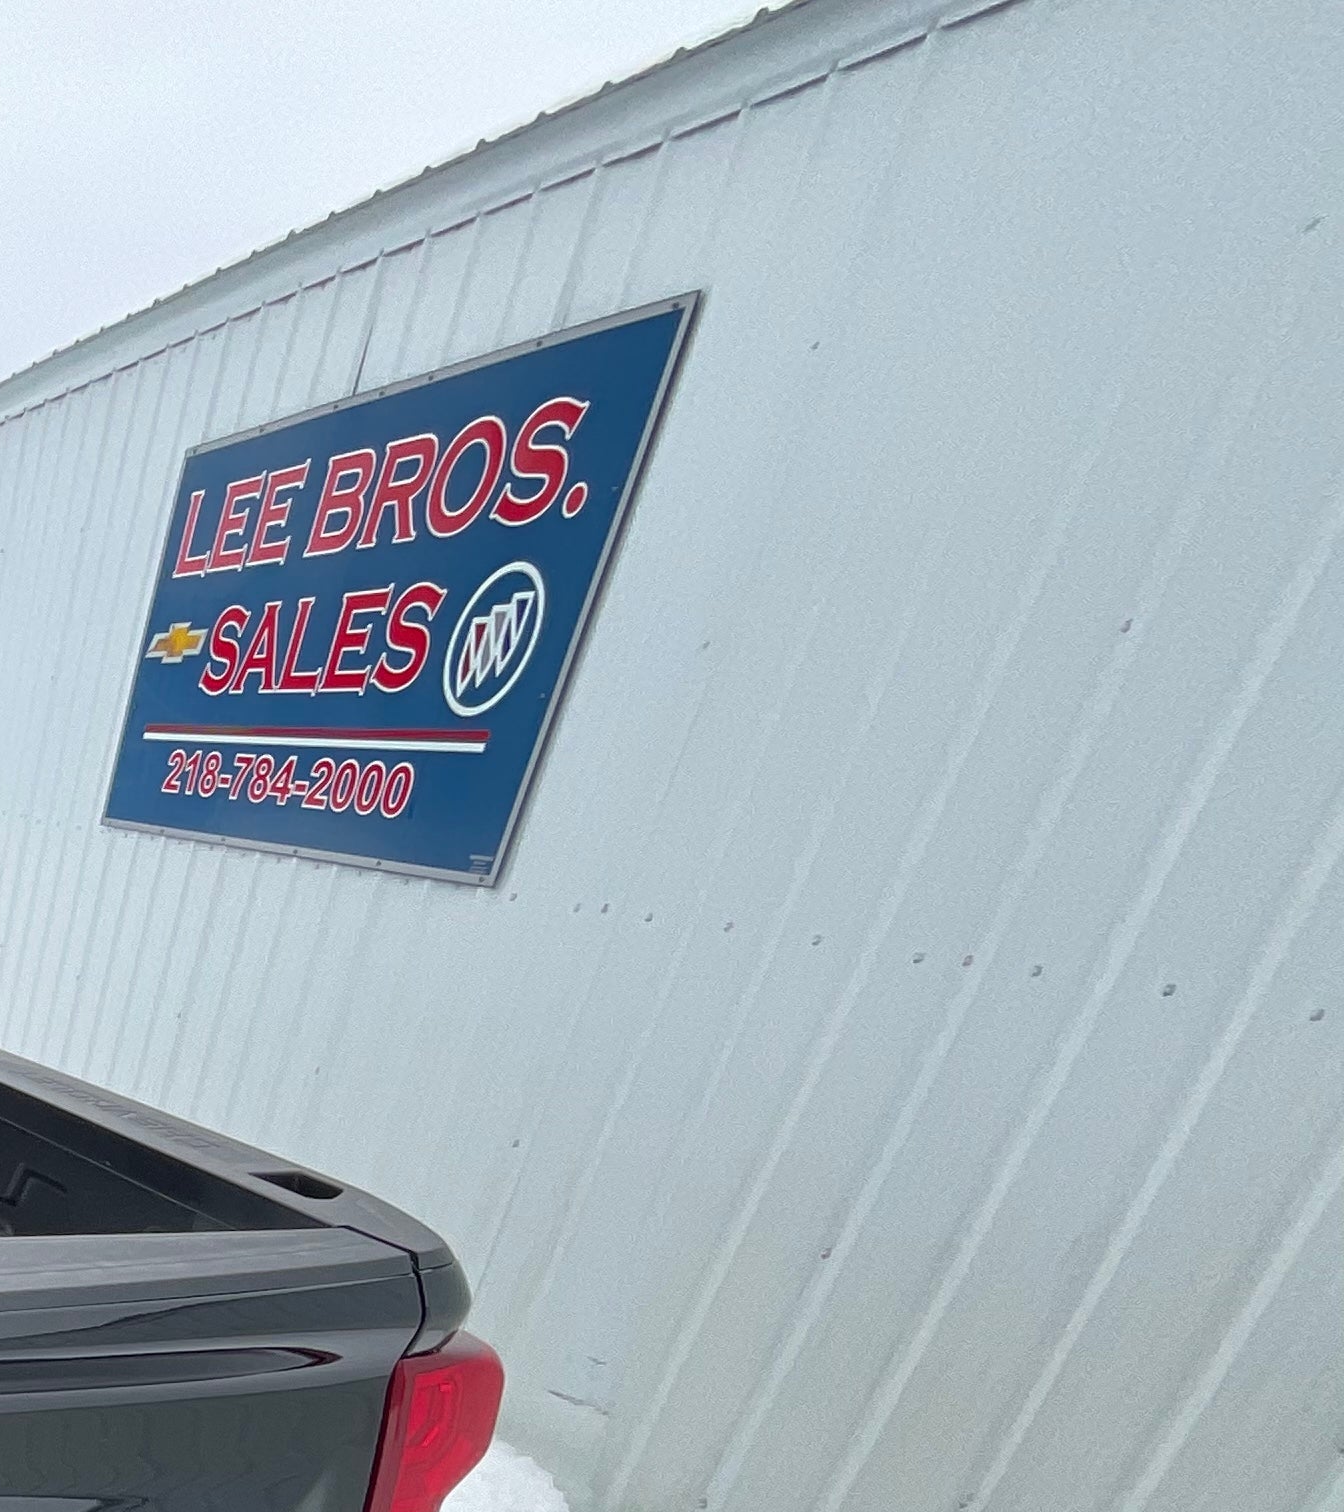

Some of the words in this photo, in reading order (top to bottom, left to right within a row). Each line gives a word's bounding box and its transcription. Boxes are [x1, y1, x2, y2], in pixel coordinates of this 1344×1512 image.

[172, 458, 312, 578] LEE
[304, 397, 589, 558] BROS.
[199, 582, 448, 697] SALES
[162, 749, 414, 818] 218-784-2000
